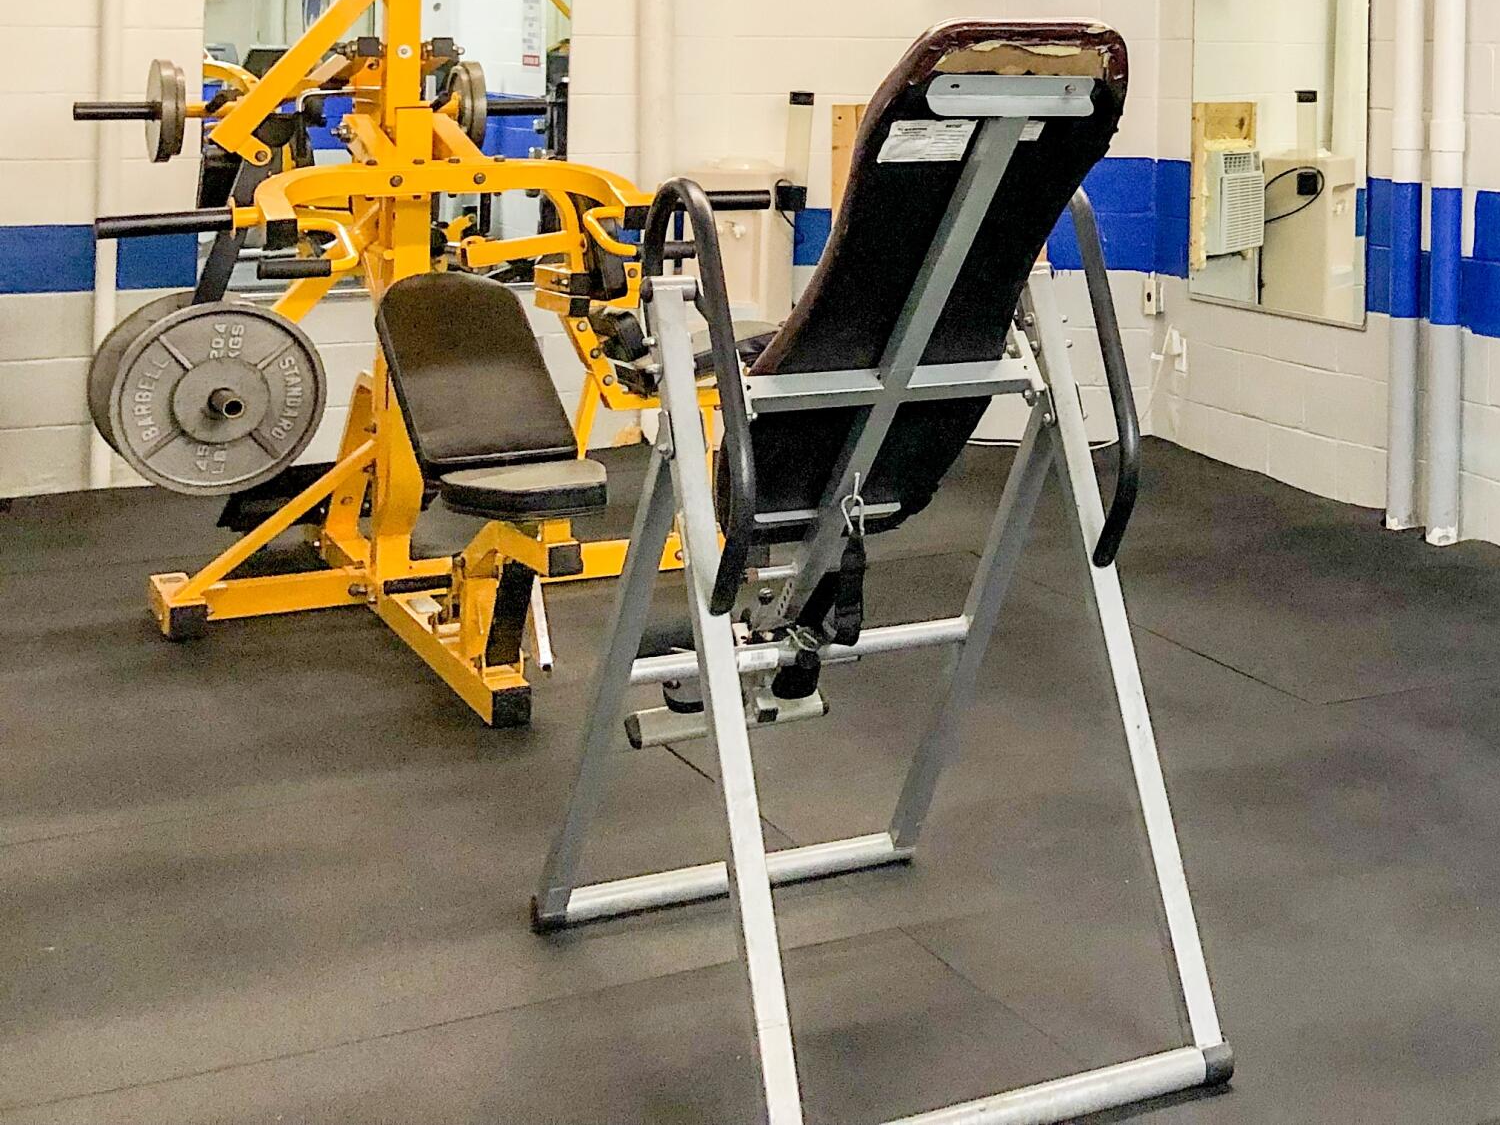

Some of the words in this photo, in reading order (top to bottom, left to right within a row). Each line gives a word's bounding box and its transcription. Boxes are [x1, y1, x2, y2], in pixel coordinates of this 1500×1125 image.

[133, 359, 171, 442] BARBELL
[271, 355, 304, 441] STANDARD
[194, 445, 210, 472] 45
